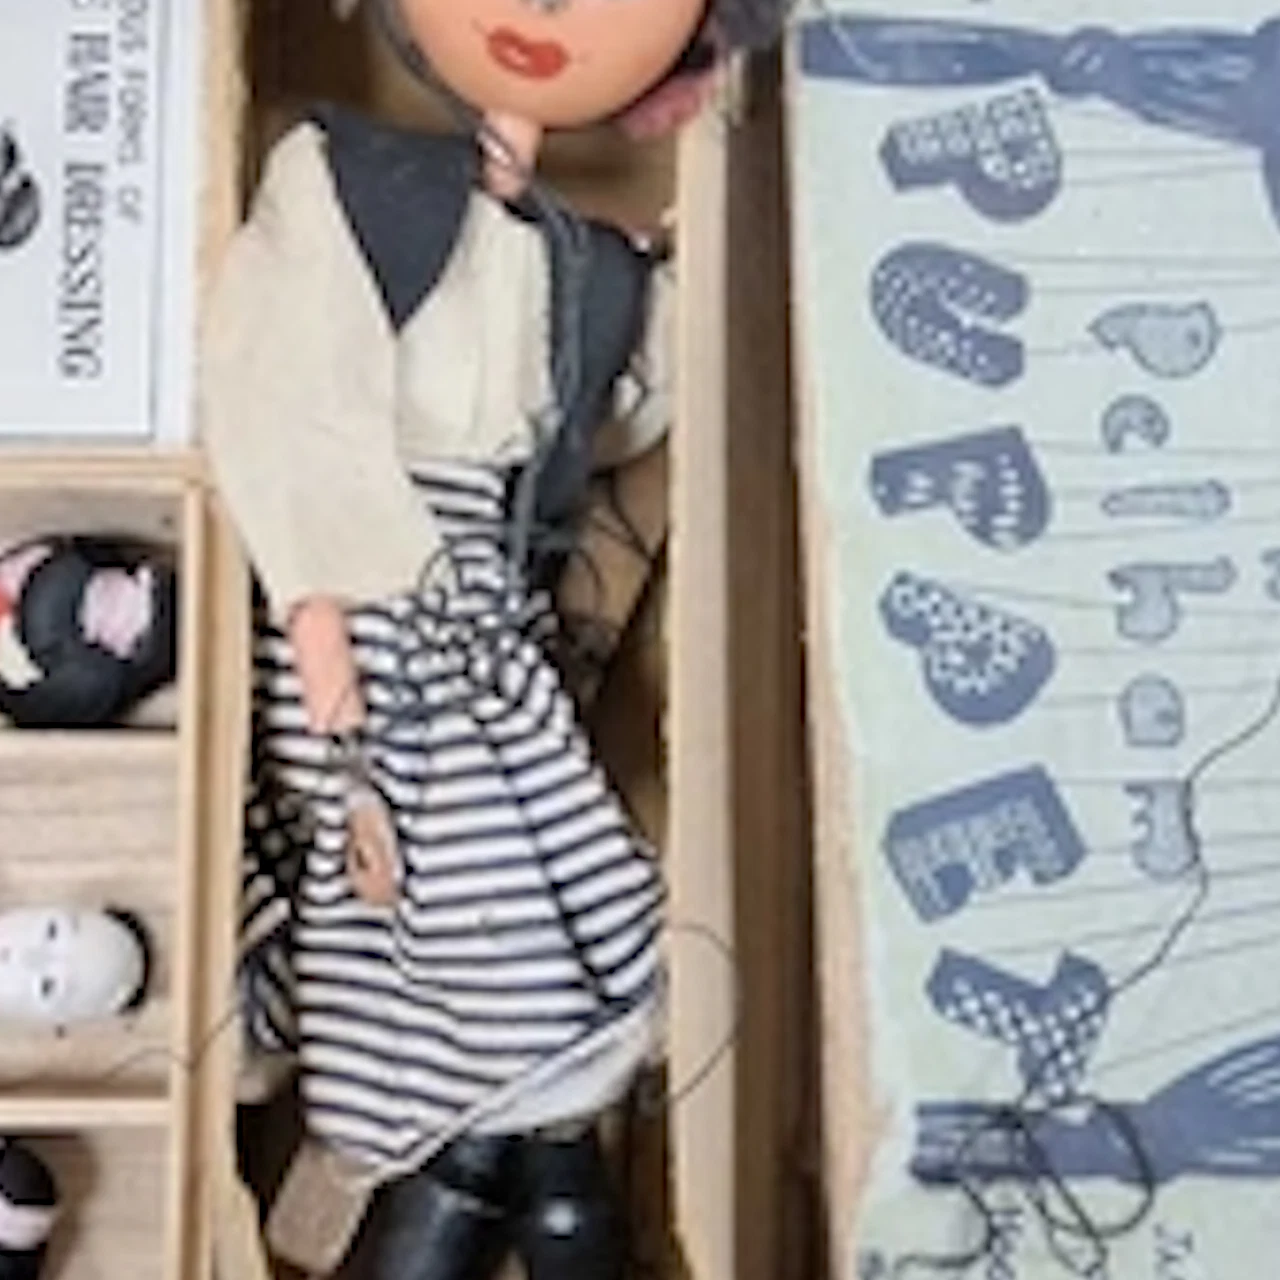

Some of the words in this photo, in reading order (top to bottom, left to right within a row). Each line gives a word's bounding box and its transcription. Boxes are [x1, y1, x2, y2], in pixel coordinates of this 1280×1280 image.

[65, 32, 110, 134] HAIR
[118, 70, 145, 167] FORMS
[59, 162, 106, 380] DRESSING
[116, 187, 143, 226] OF
[866, 82, 1112, 1114] PUPPET
[1087, 300, 1238, 884] Pelham
